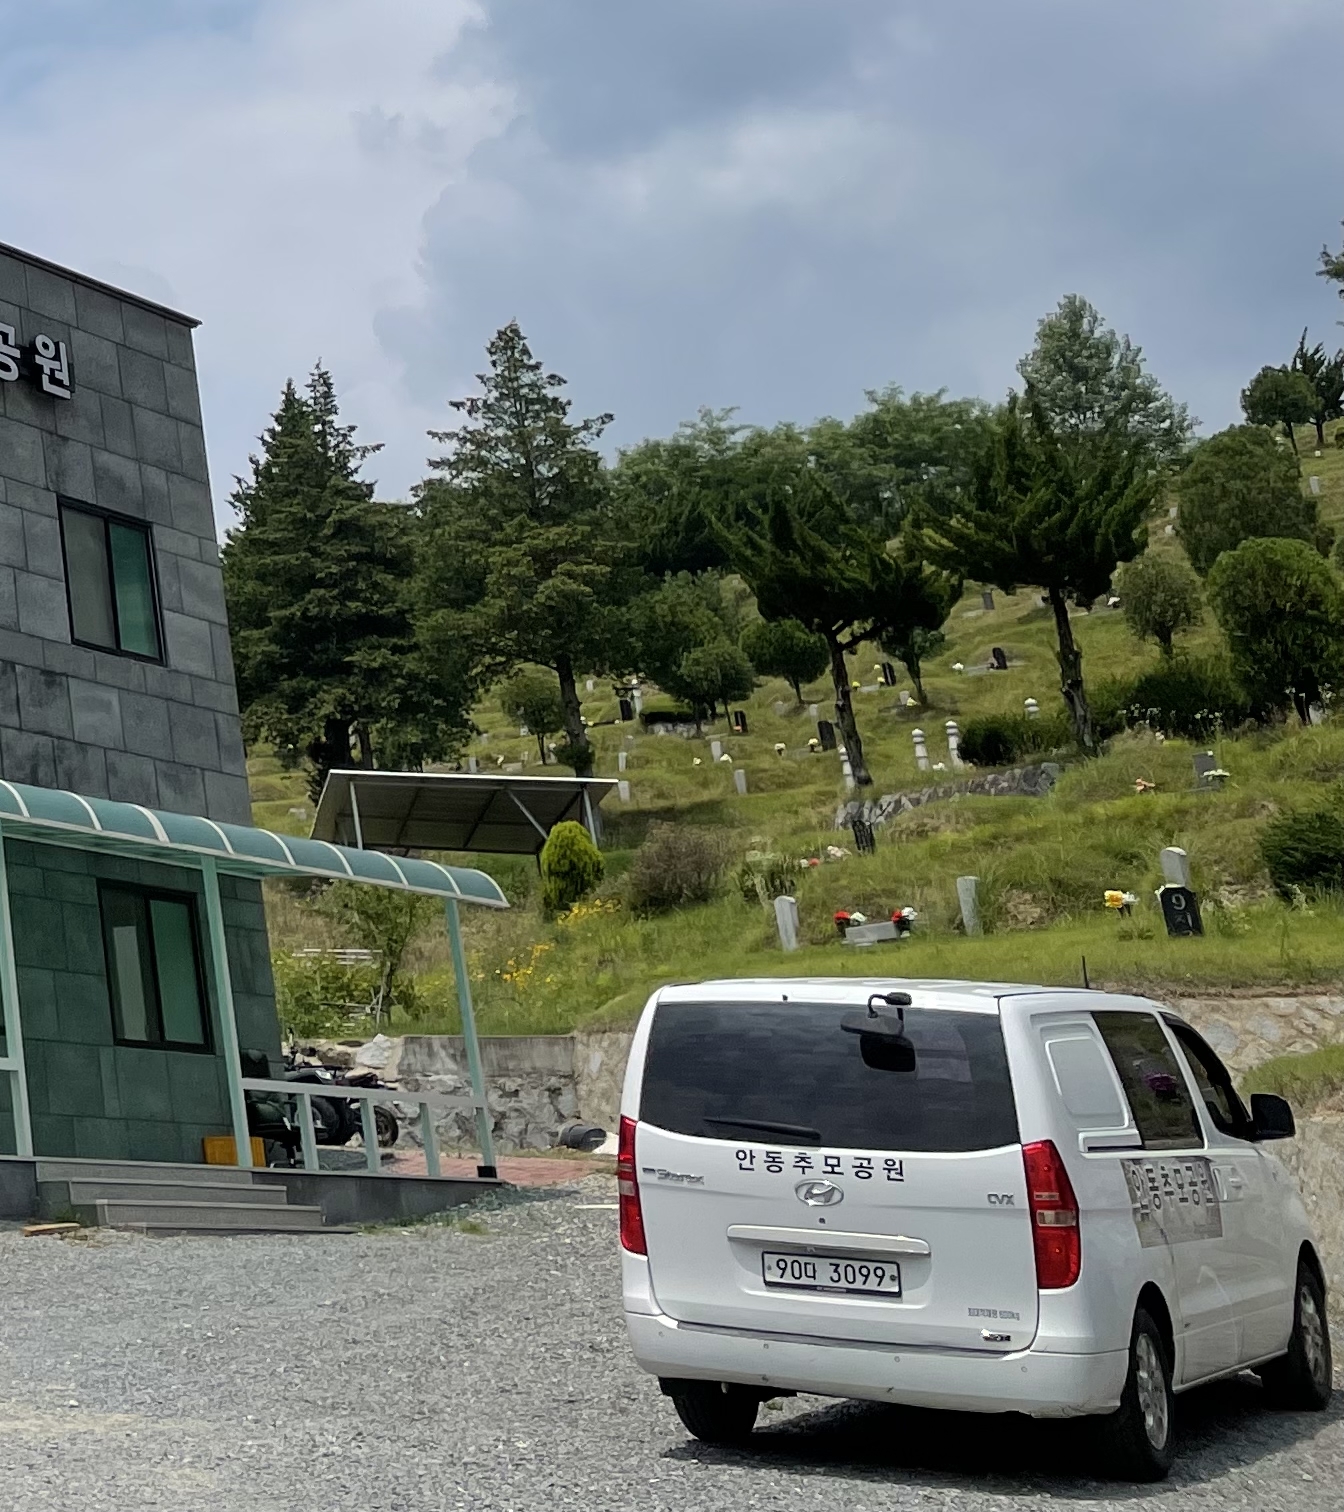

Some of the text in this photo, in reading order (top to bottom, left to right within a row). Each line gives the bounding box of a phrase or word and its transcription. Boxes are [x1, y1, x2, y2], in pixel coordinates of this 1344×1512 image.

[735, 1149, 905, 1183] 안동추모공원
[987, 1193, 1015, 1206] CVX
[775, 1258, 887, 1287] 90다 3099
